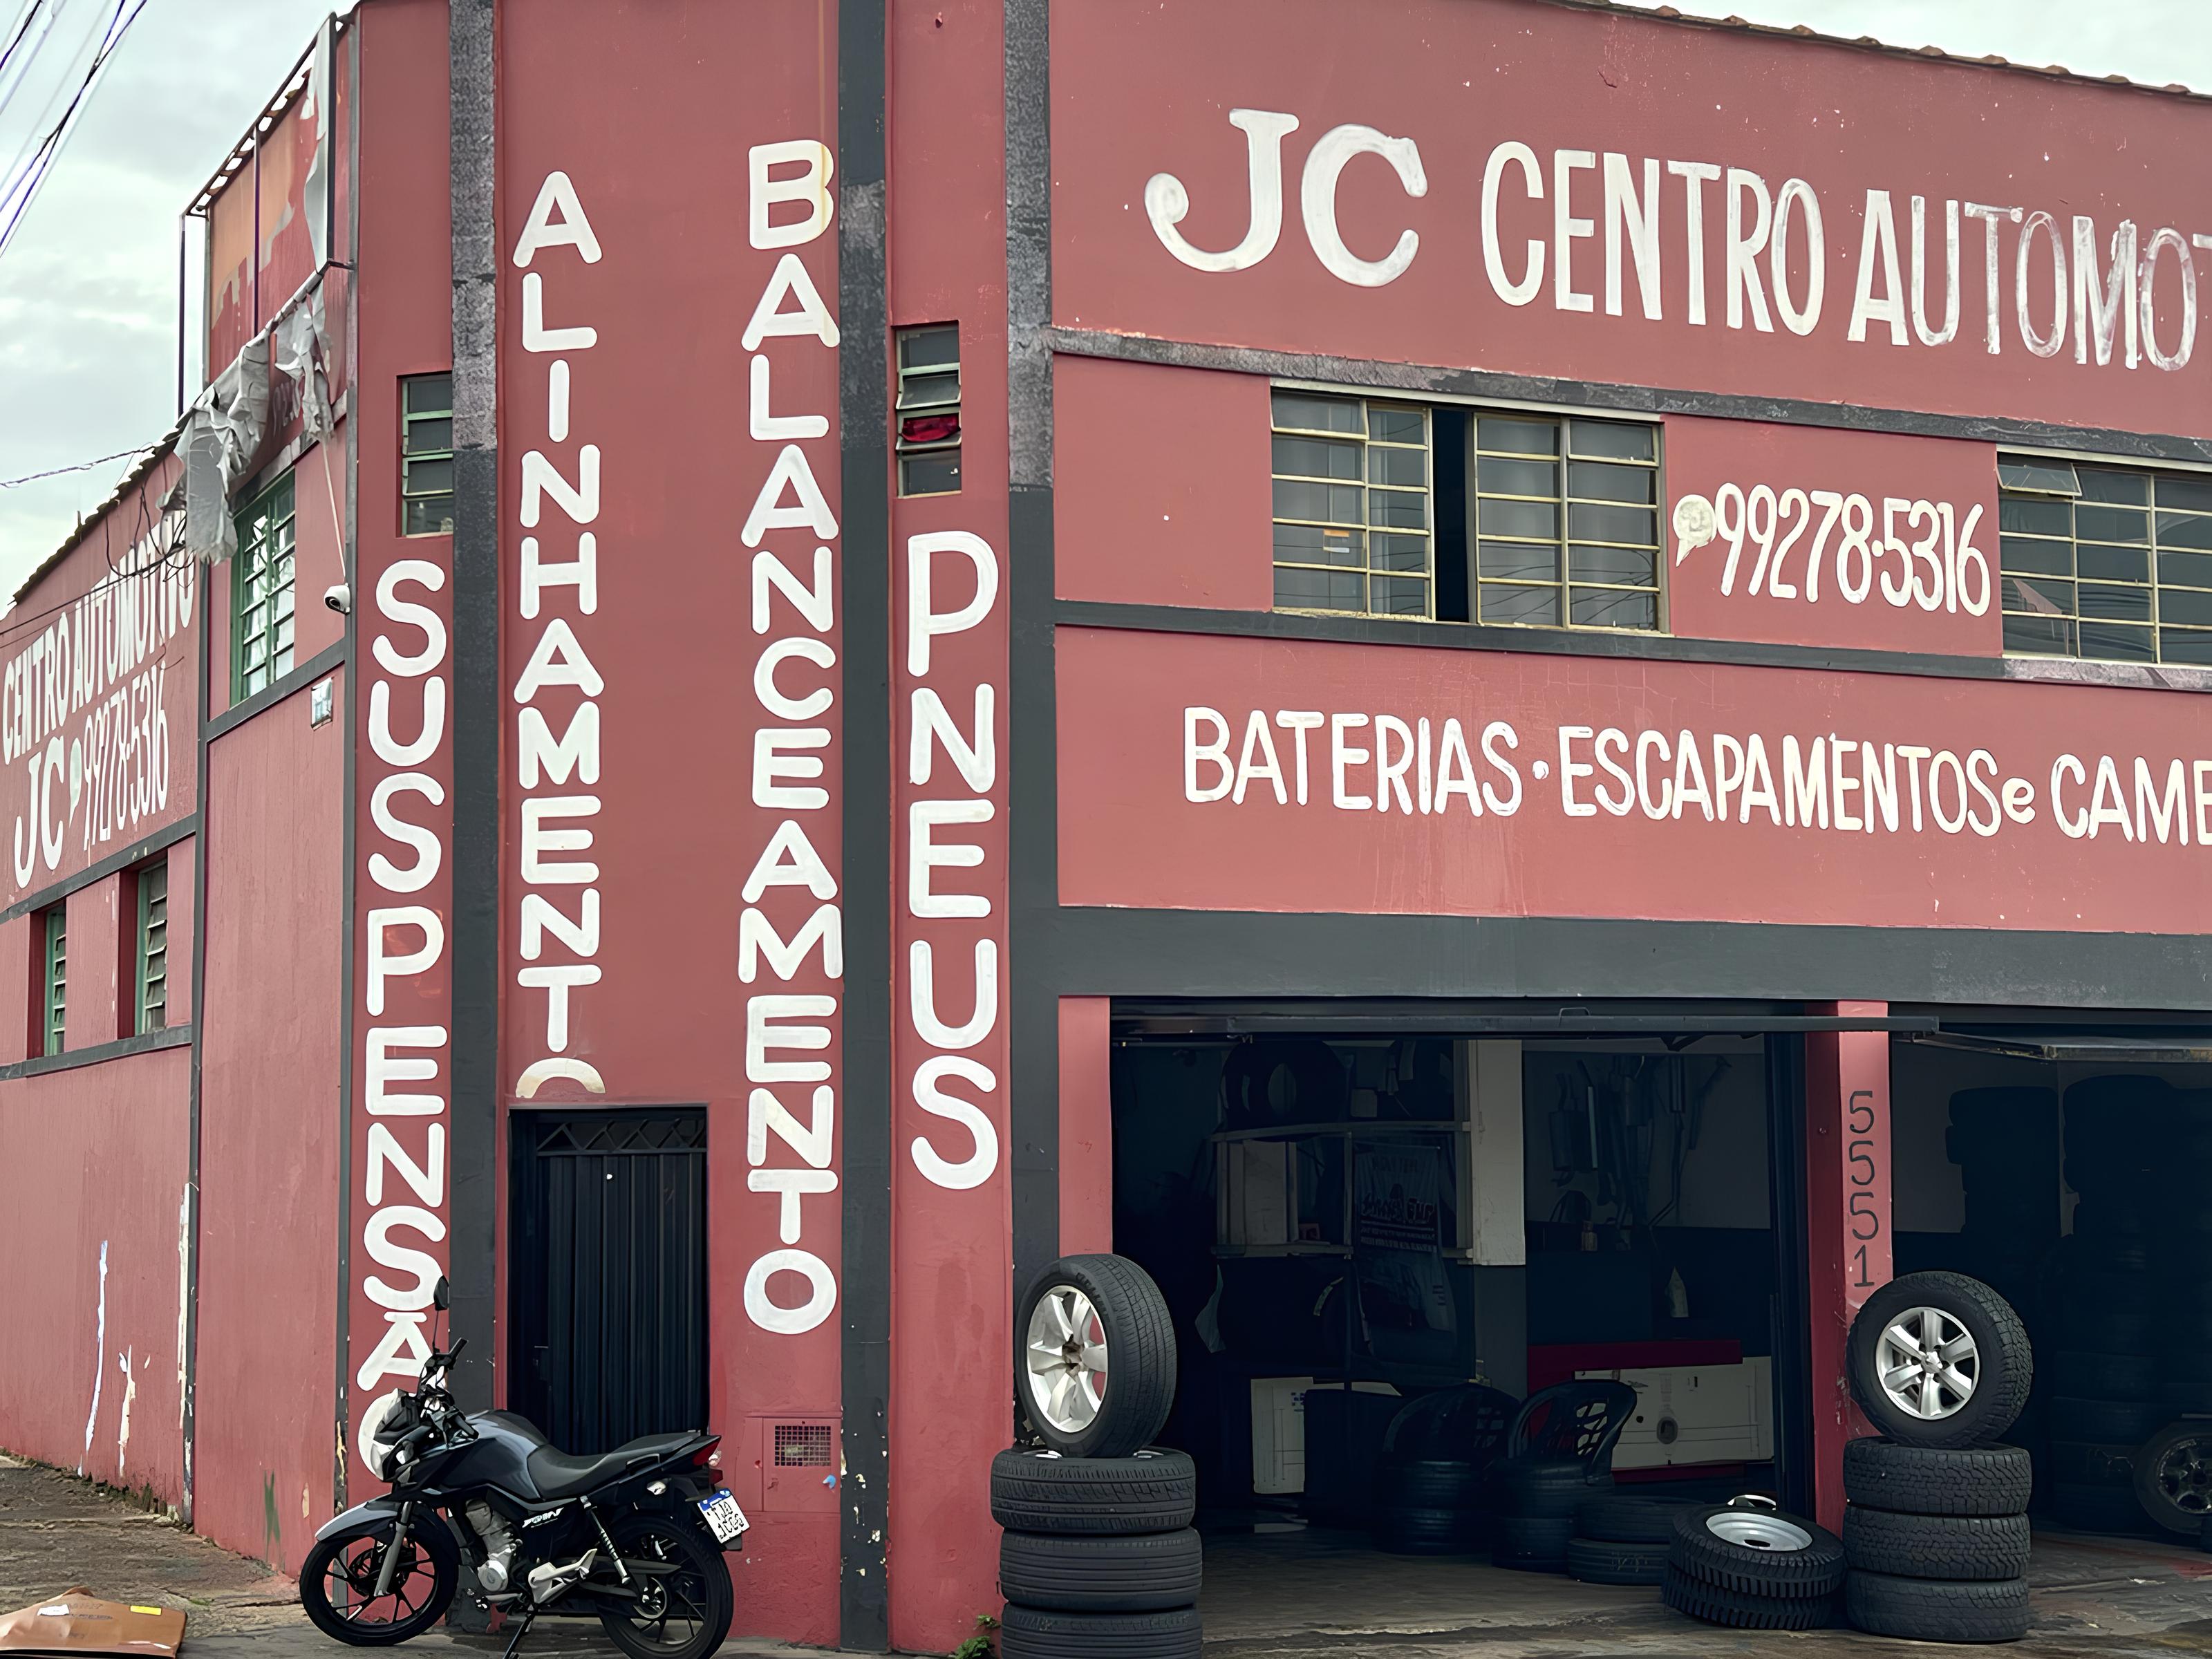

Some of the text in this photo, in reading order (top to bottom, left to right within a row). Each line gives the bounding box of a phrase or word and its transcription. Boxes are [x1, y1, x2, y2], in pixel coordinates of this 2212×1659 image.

[1144, 108, 1428, 288] JC
[1481, 141, 1825, 337] CENTRO
[2, 611, 69, 765] CENTRO
[738, 140, 842, 1335] BALANCEAMENTO
[1184, 706, 1523, 816] BATERIAS
[1559, 725, 2002, 837] ESCAPAMENTOS
[15, 735, 64, 889] JC
[909, 530, 999, 1190] PNEUS
[1848, 1090, 1879, 1288] 5551
